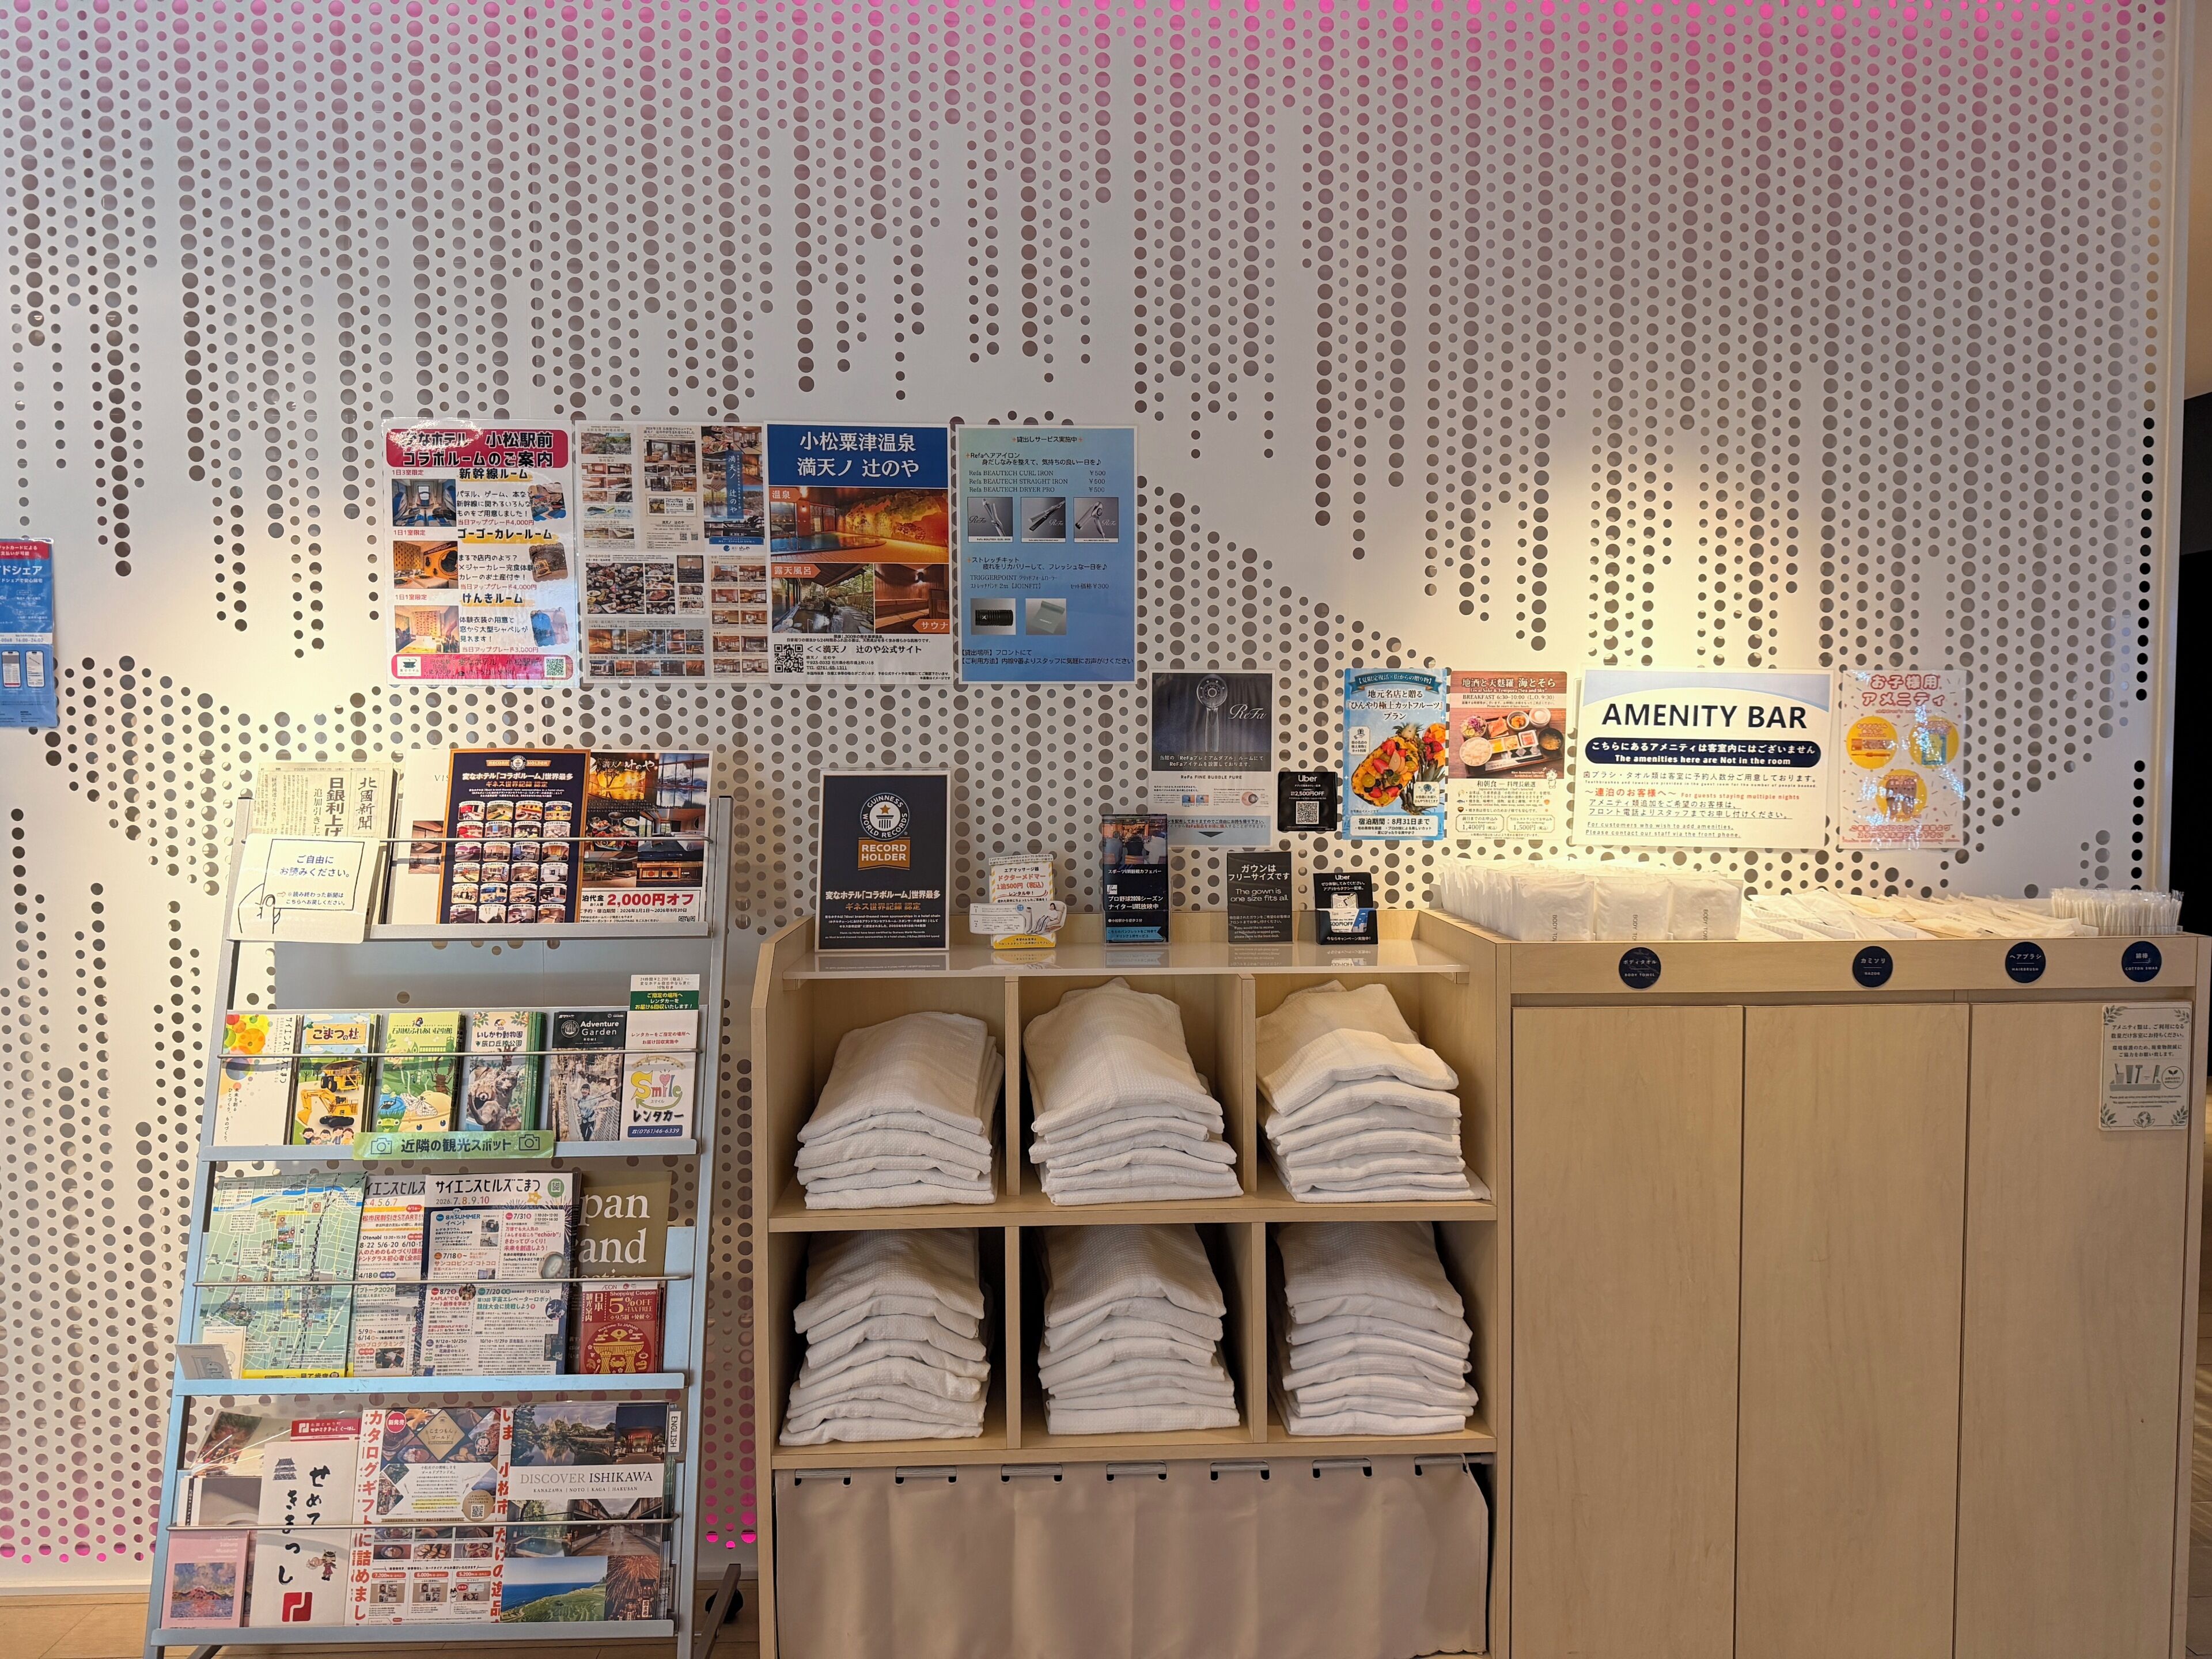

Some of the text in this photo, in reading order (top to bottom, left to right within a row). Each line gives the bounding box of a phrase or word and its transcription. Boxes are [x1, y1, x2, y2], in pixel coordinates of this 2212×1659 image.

[486, 431, 553, 448] 小松駅前
[800, 431, 916, 452] 小松粟津温泉
[403, 452, 554, 467] コラボルームのご案内
[459, 468, 528, 479] 新幹線ルーム
[797, 457, 919, 478] 満天ノ 辻のや
[772, 490, 790, 499] 温泉
[458, 529, 552, 539] ゴーゴーカレールーム
[774, 566, 811, 575] 露天風呂
[856, 645, 922, 653] 辻のや公式サイト
[1518, 678, 1555, 687] 海とそら
[1870, 675, 1940, 690] お子様用
[1368, 690, 1423, 698] 地元名店と贈る
[1862, 692, 1945, 706] アメニティ
[1228, 703, 1266, 719] ReFa
[1601, 703, 1807, 728] AMENITY BAR
[1592, 741, 1815, 755] こちらにあるアメニティは客室内にはございません
[1634, 755, 1678, 763] amenities
[324, 777, 345, 836] 日銀利上げ
[356, 777, 377, 830] 北國新聞
[867, 795, 904, 808] GUINNESS
[863, 813, 907, 838] WORLD RECORDS
[297, 855, 334, 864] ご自由に
[280, 867, 350, 877] お読みください。
[1241, 865, 1276, 873] ガウンは
[1229, 873, 1290, 881] フリーサイズです
[607, 893, 694, 907] 2,000円オフ
[825, 891, 940, 899] 変なホテル「コラボルーム」世界最多
[313, 1028, 361, 1040] こまつの杜
[630, 1070, 683, 1100] Smile
[634, 1109, 684, 1123] レンタカー
[401, 1138, 512, 1153] 近隣の観光スポット
[435, 1179, 540, 1194] サイエンスヒルズこまつ
[594, 1293, 603, 1311] 日本
[520, 1472, 653, 1484] DISCOVER ISHIKAWA
[306, 1465, 330, 1525] せめて
